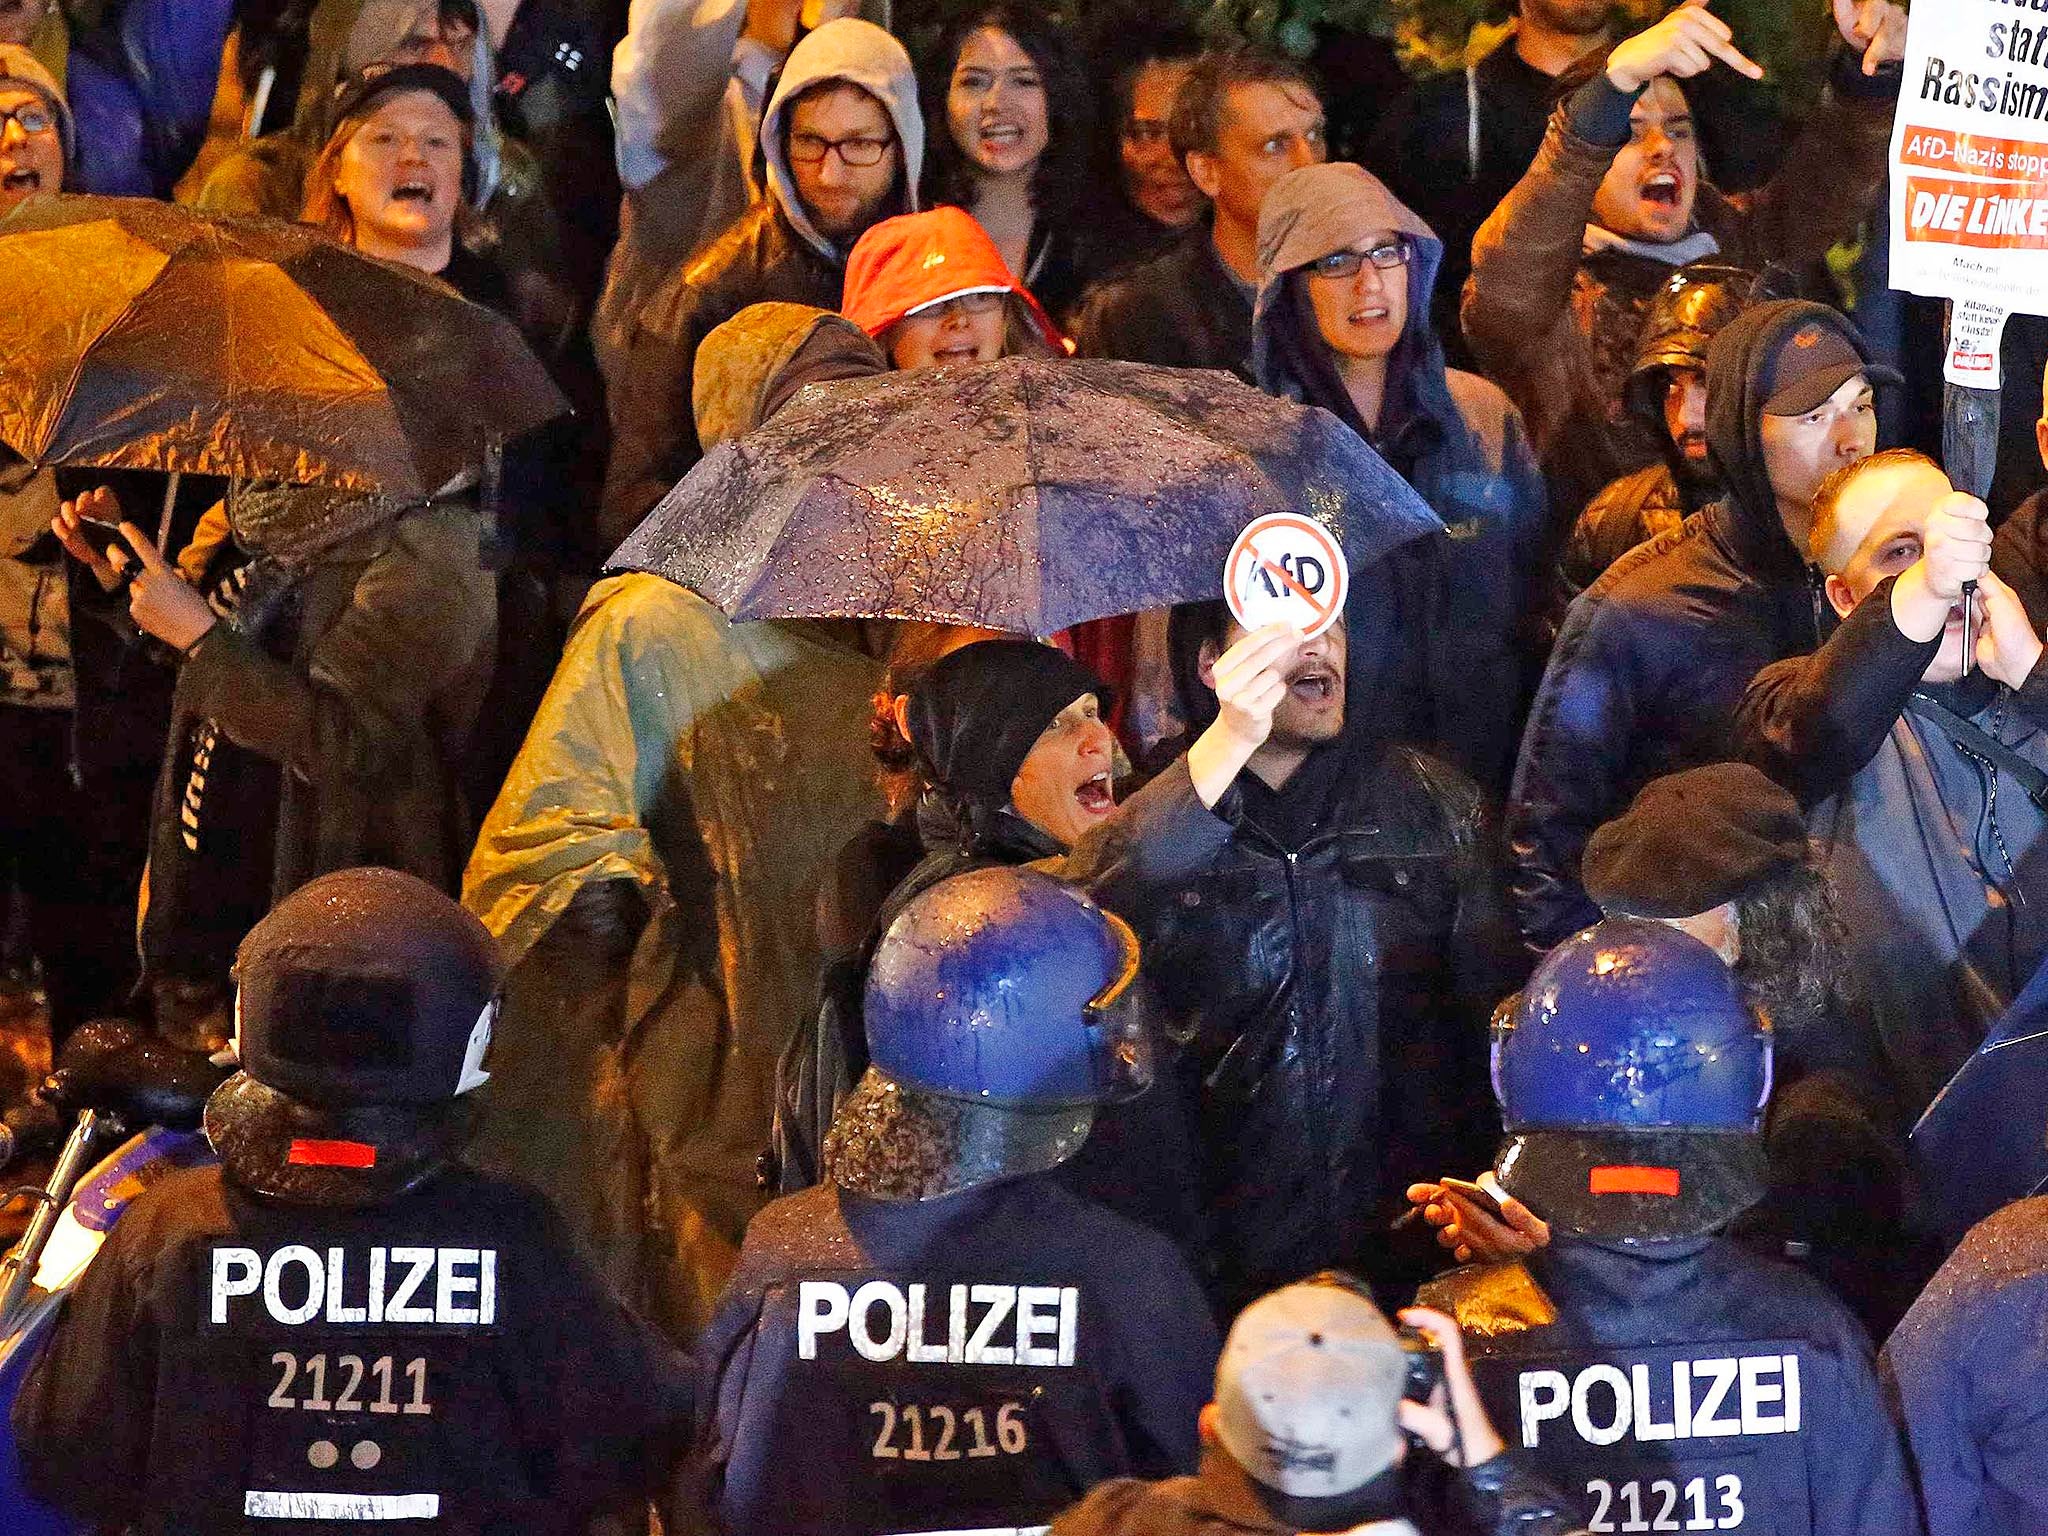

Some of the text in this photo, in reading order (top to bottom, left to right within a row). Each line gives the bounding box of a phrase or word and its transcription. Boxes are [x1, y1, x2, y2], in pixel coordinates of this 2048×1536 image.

[1986, 20, 2048, 68] stat
[1920, 57, 2048, 121] Rassism
[1907, 135, 2004, 169] AfD-Nazis
[1911, 191, 1969, 231] DIE
[1953, 257, 1983, 271] Mach
[1244, 553, 1325, 600] AfD
[211, 1245, 497, 1325] POLIZEI
[798, 1280, 1079, 1366] POLIZEI
[268, 1352, 432, 1414] 21211
[1519, 1354, 1800, 1448] POLIZEI
[870, 1402, 1027, 1461] 21216
[1586, 1474, 1745, 1532] 21213
